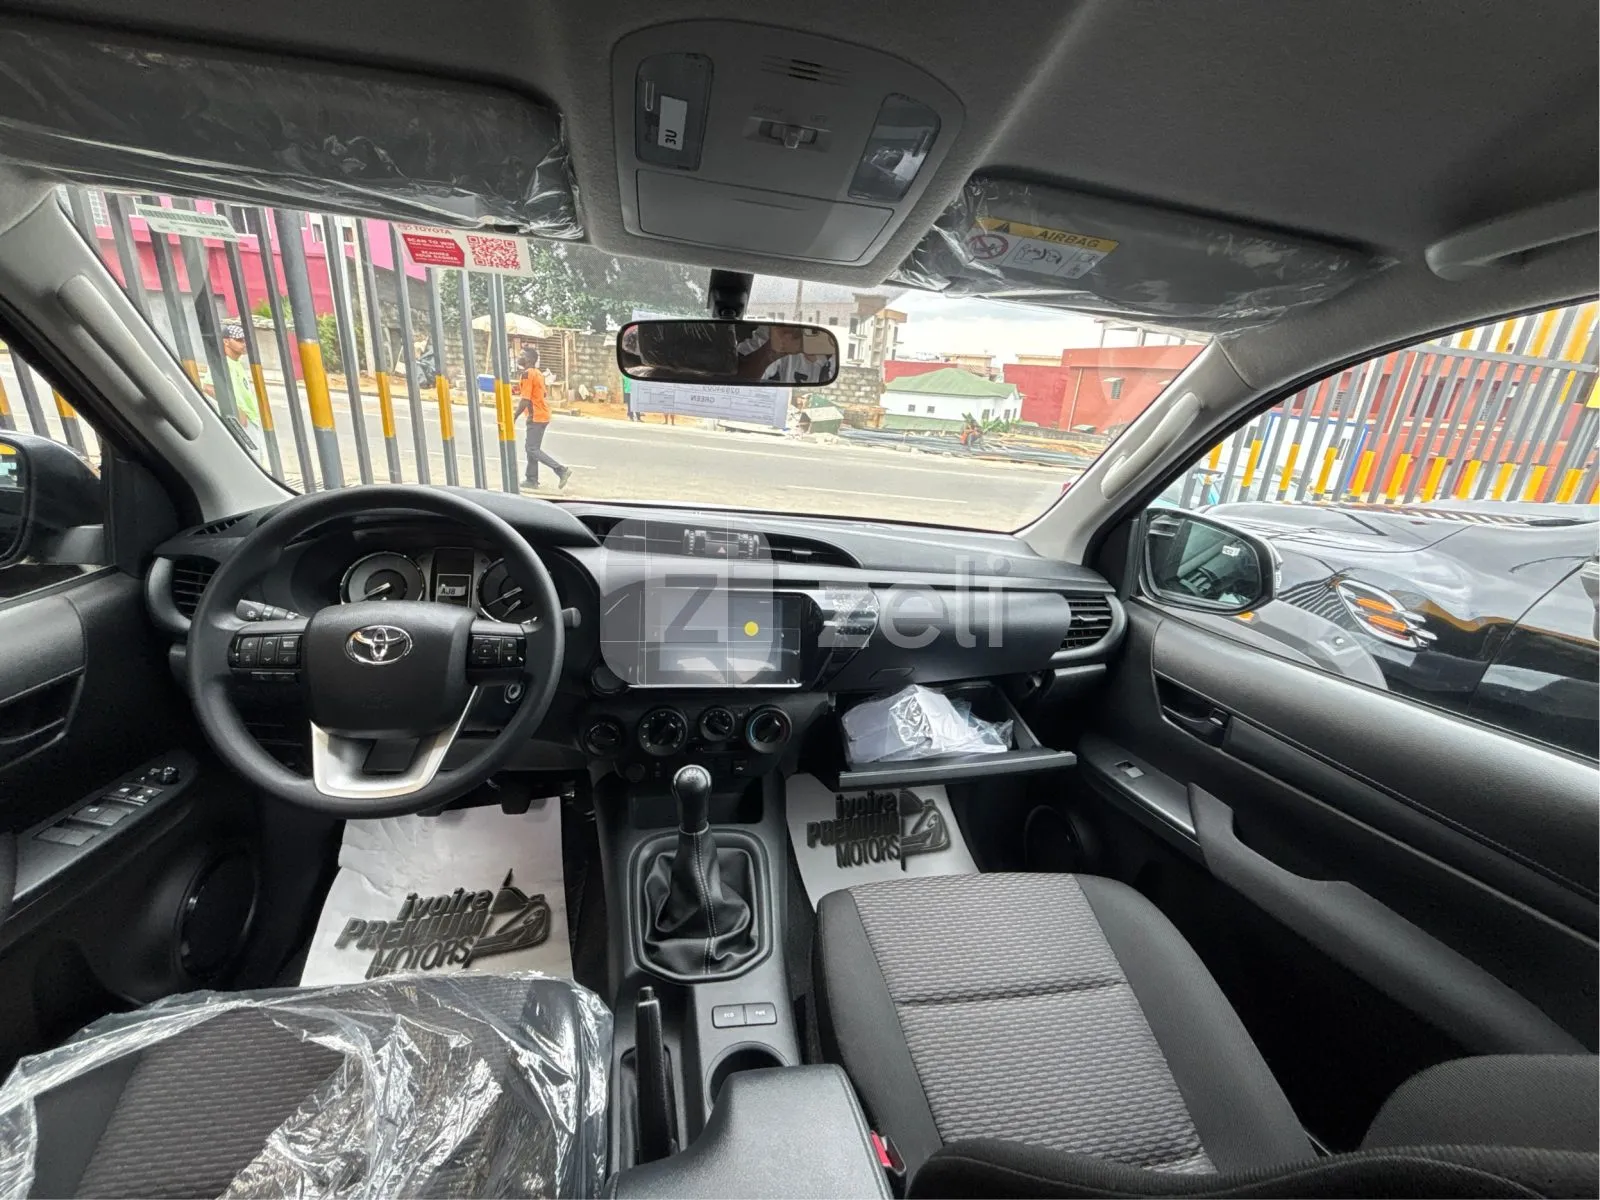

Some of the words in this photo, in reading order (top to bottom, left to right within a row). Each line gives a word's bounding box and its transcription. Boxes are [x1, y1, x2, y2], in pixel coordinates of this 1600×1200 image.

[664, 128, 678, 145] 3U
[415, 225, 453, 235] TOYOTA
[1036, 230, 1101, 248] AIRBAG
[836, 790, 898, 819] ivoire
[807, 812, 901, 849] PREMIUM
[836, 836, 900, 868] MOTORS
[397, 887, 494, 921] ivoire
[334, 910, 493, 950] PREMIUM
[364, 936, 477, 980] MOTORS
